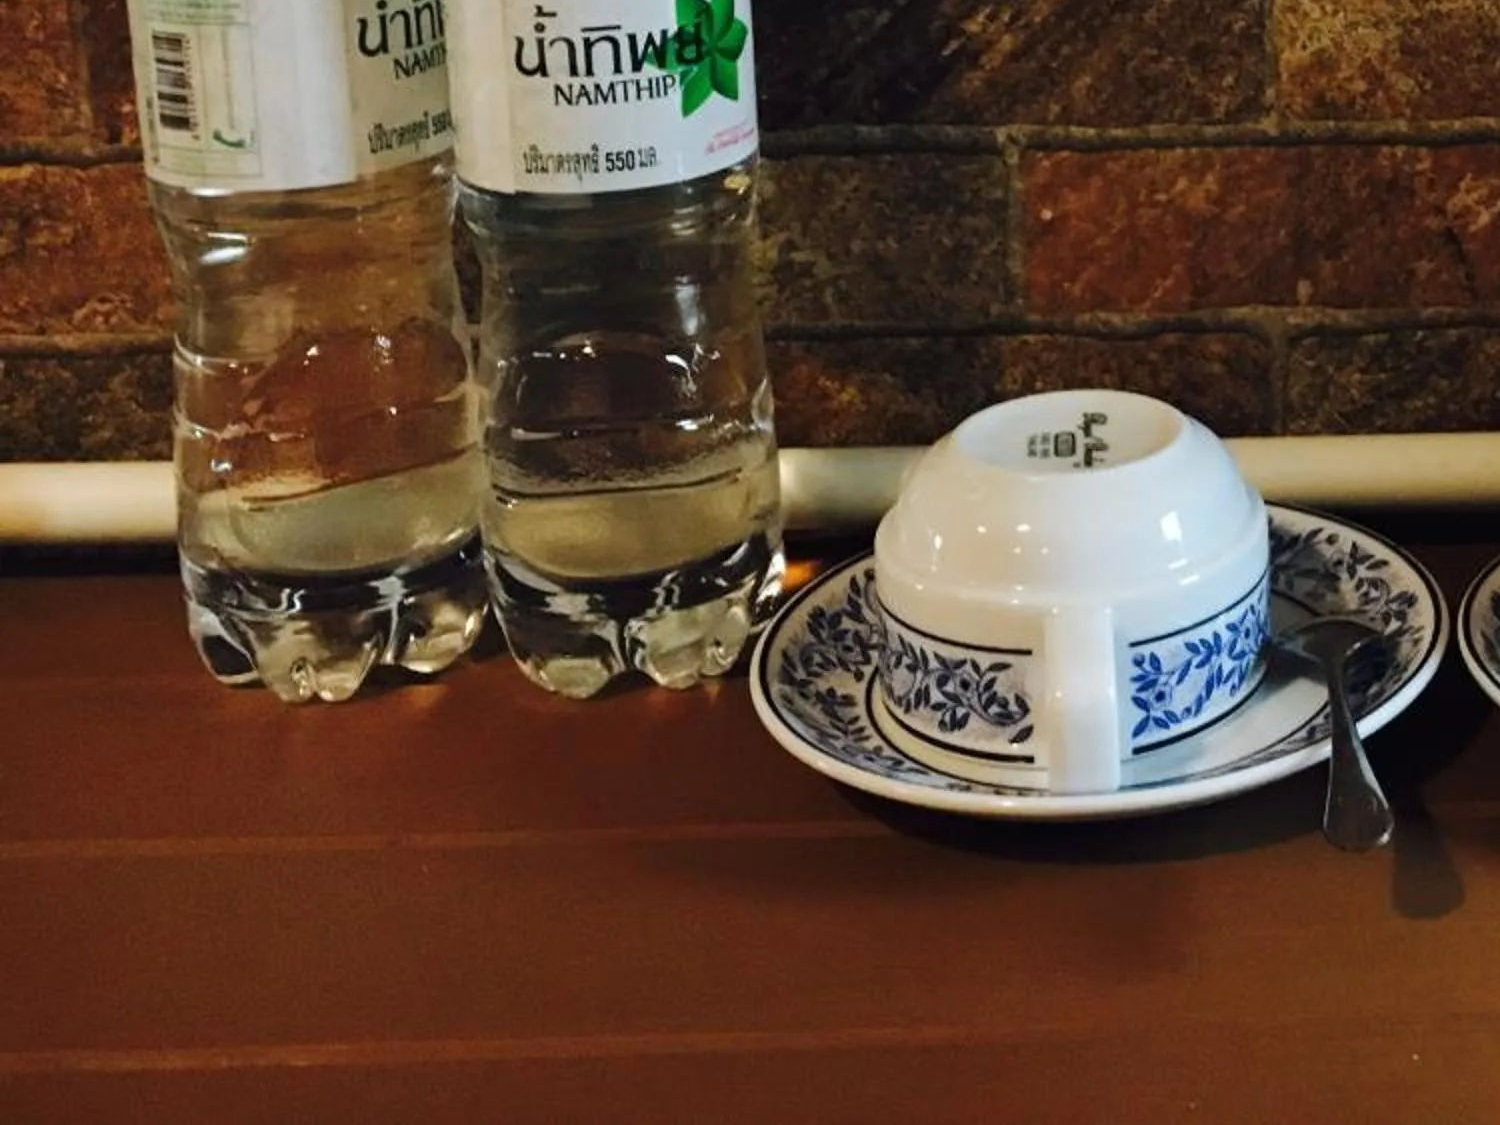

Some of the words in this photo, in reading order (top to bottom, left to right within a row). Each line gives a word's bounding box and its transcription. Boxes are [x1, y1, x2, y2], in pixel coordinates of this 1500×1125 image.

[393, 41, 447, 80] NAMT
[553, 74, 677, 106] NAMTHIP
[605, 150, 635, 172] 550
